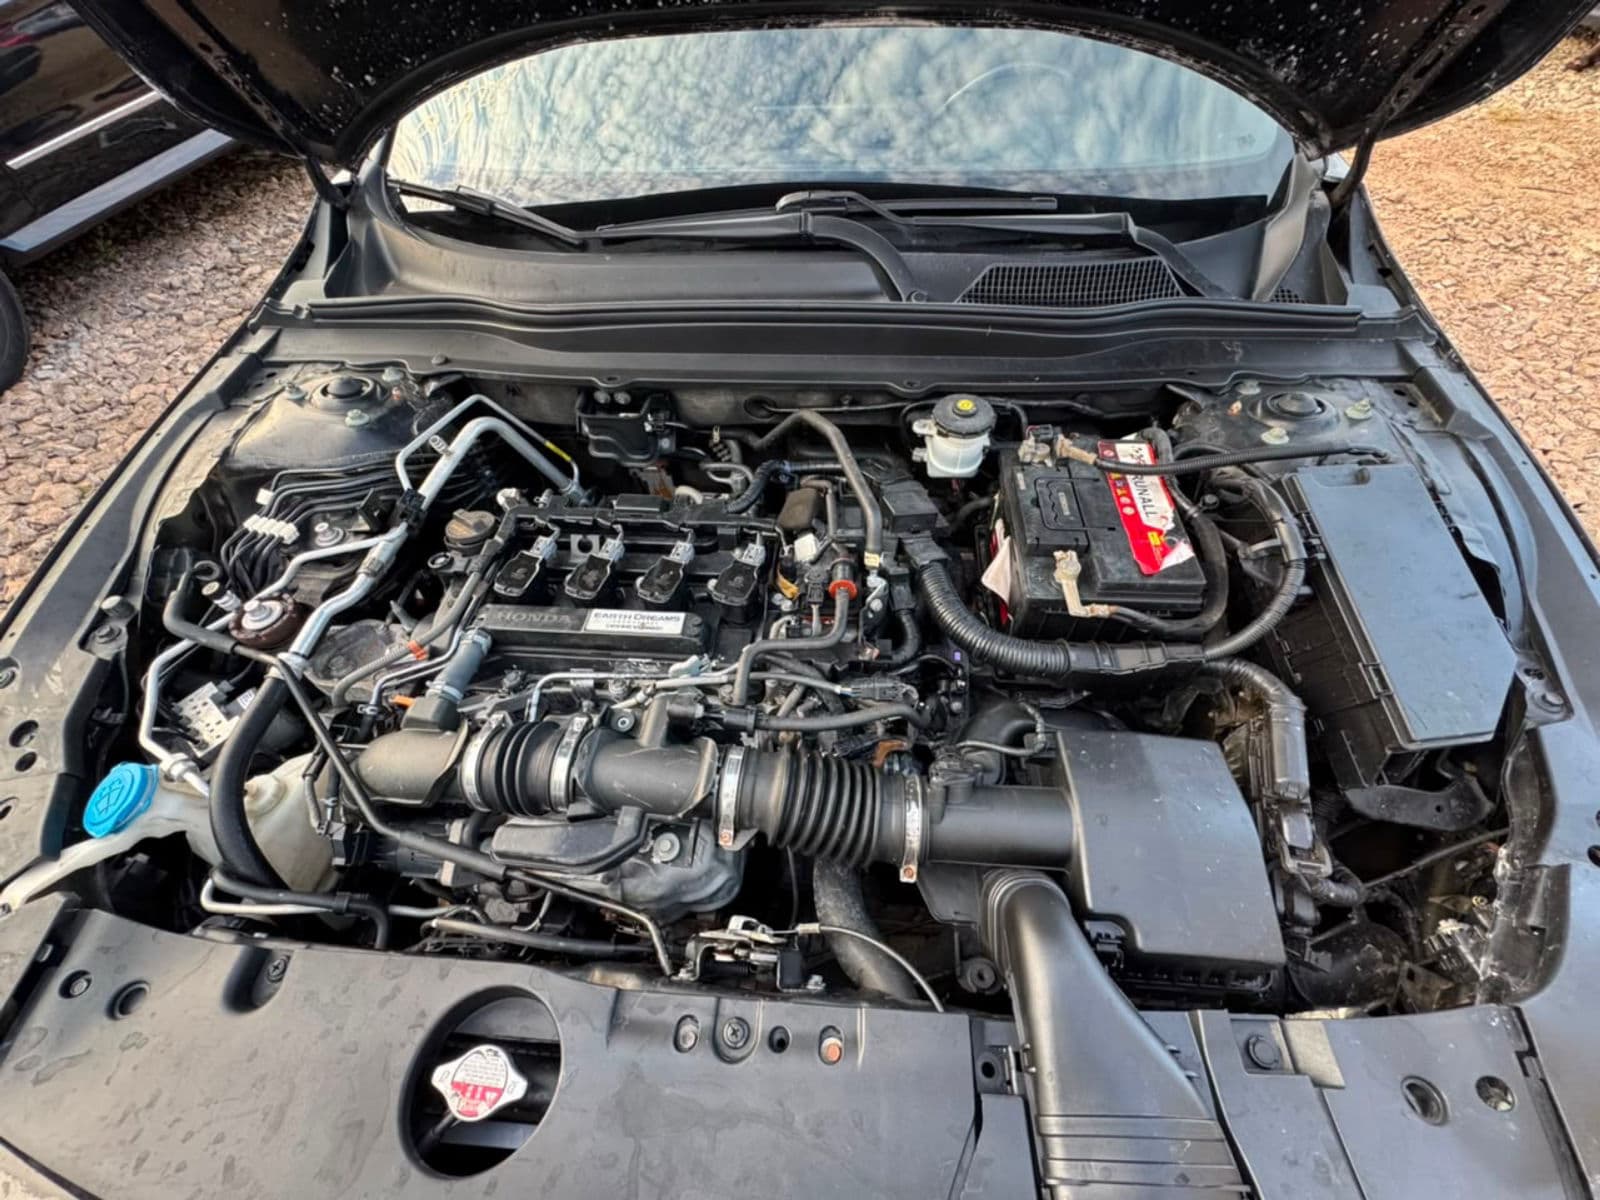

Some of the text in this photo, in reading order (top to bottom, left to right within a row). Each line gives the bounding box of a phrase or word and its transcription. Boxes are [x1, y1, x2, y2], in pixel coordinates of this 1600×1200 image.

[496, 611, 571, 624] HONDA
[593, 612, 632, 620] EARTH
[633, 613, 681, 622] DREAMS
